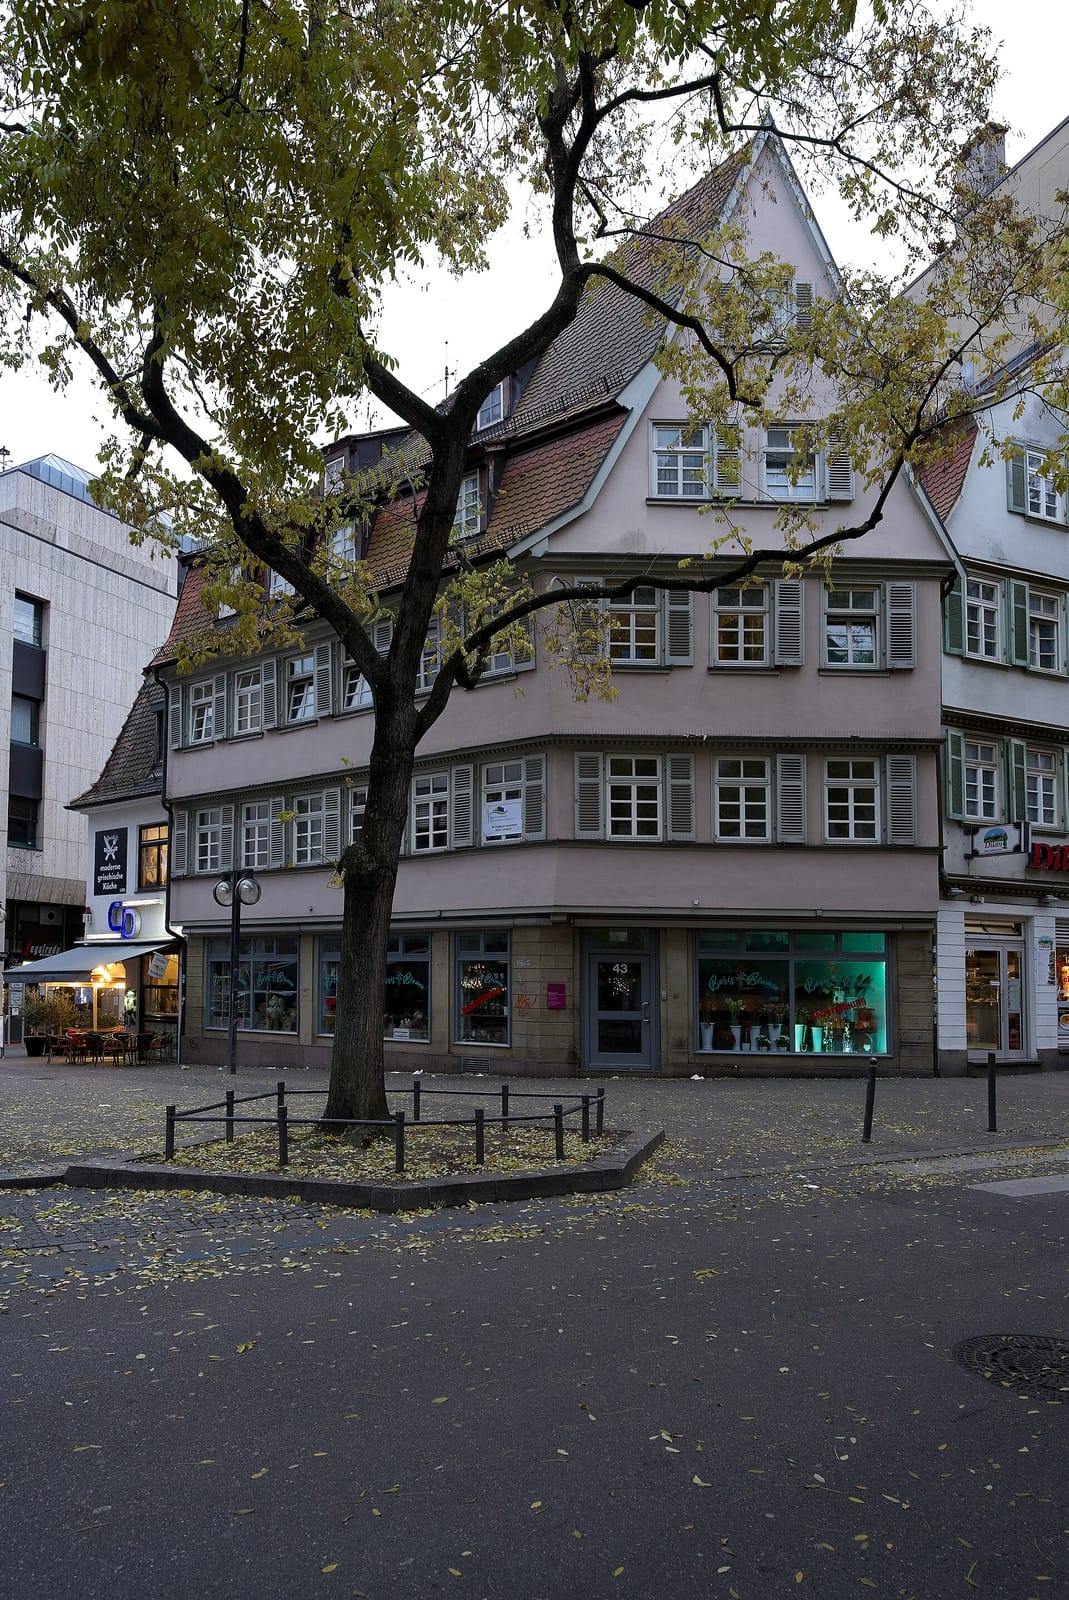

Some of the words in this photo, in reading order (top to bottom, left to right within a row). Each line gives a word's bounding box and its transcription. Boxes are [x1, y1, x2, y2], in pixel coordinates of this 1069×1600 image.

[100, 863, 121, 872] moderne
[97, 872, 124, 883] griechische
[102, 882, 118, 890] Küche
[612, 963, 628, 974] 43
